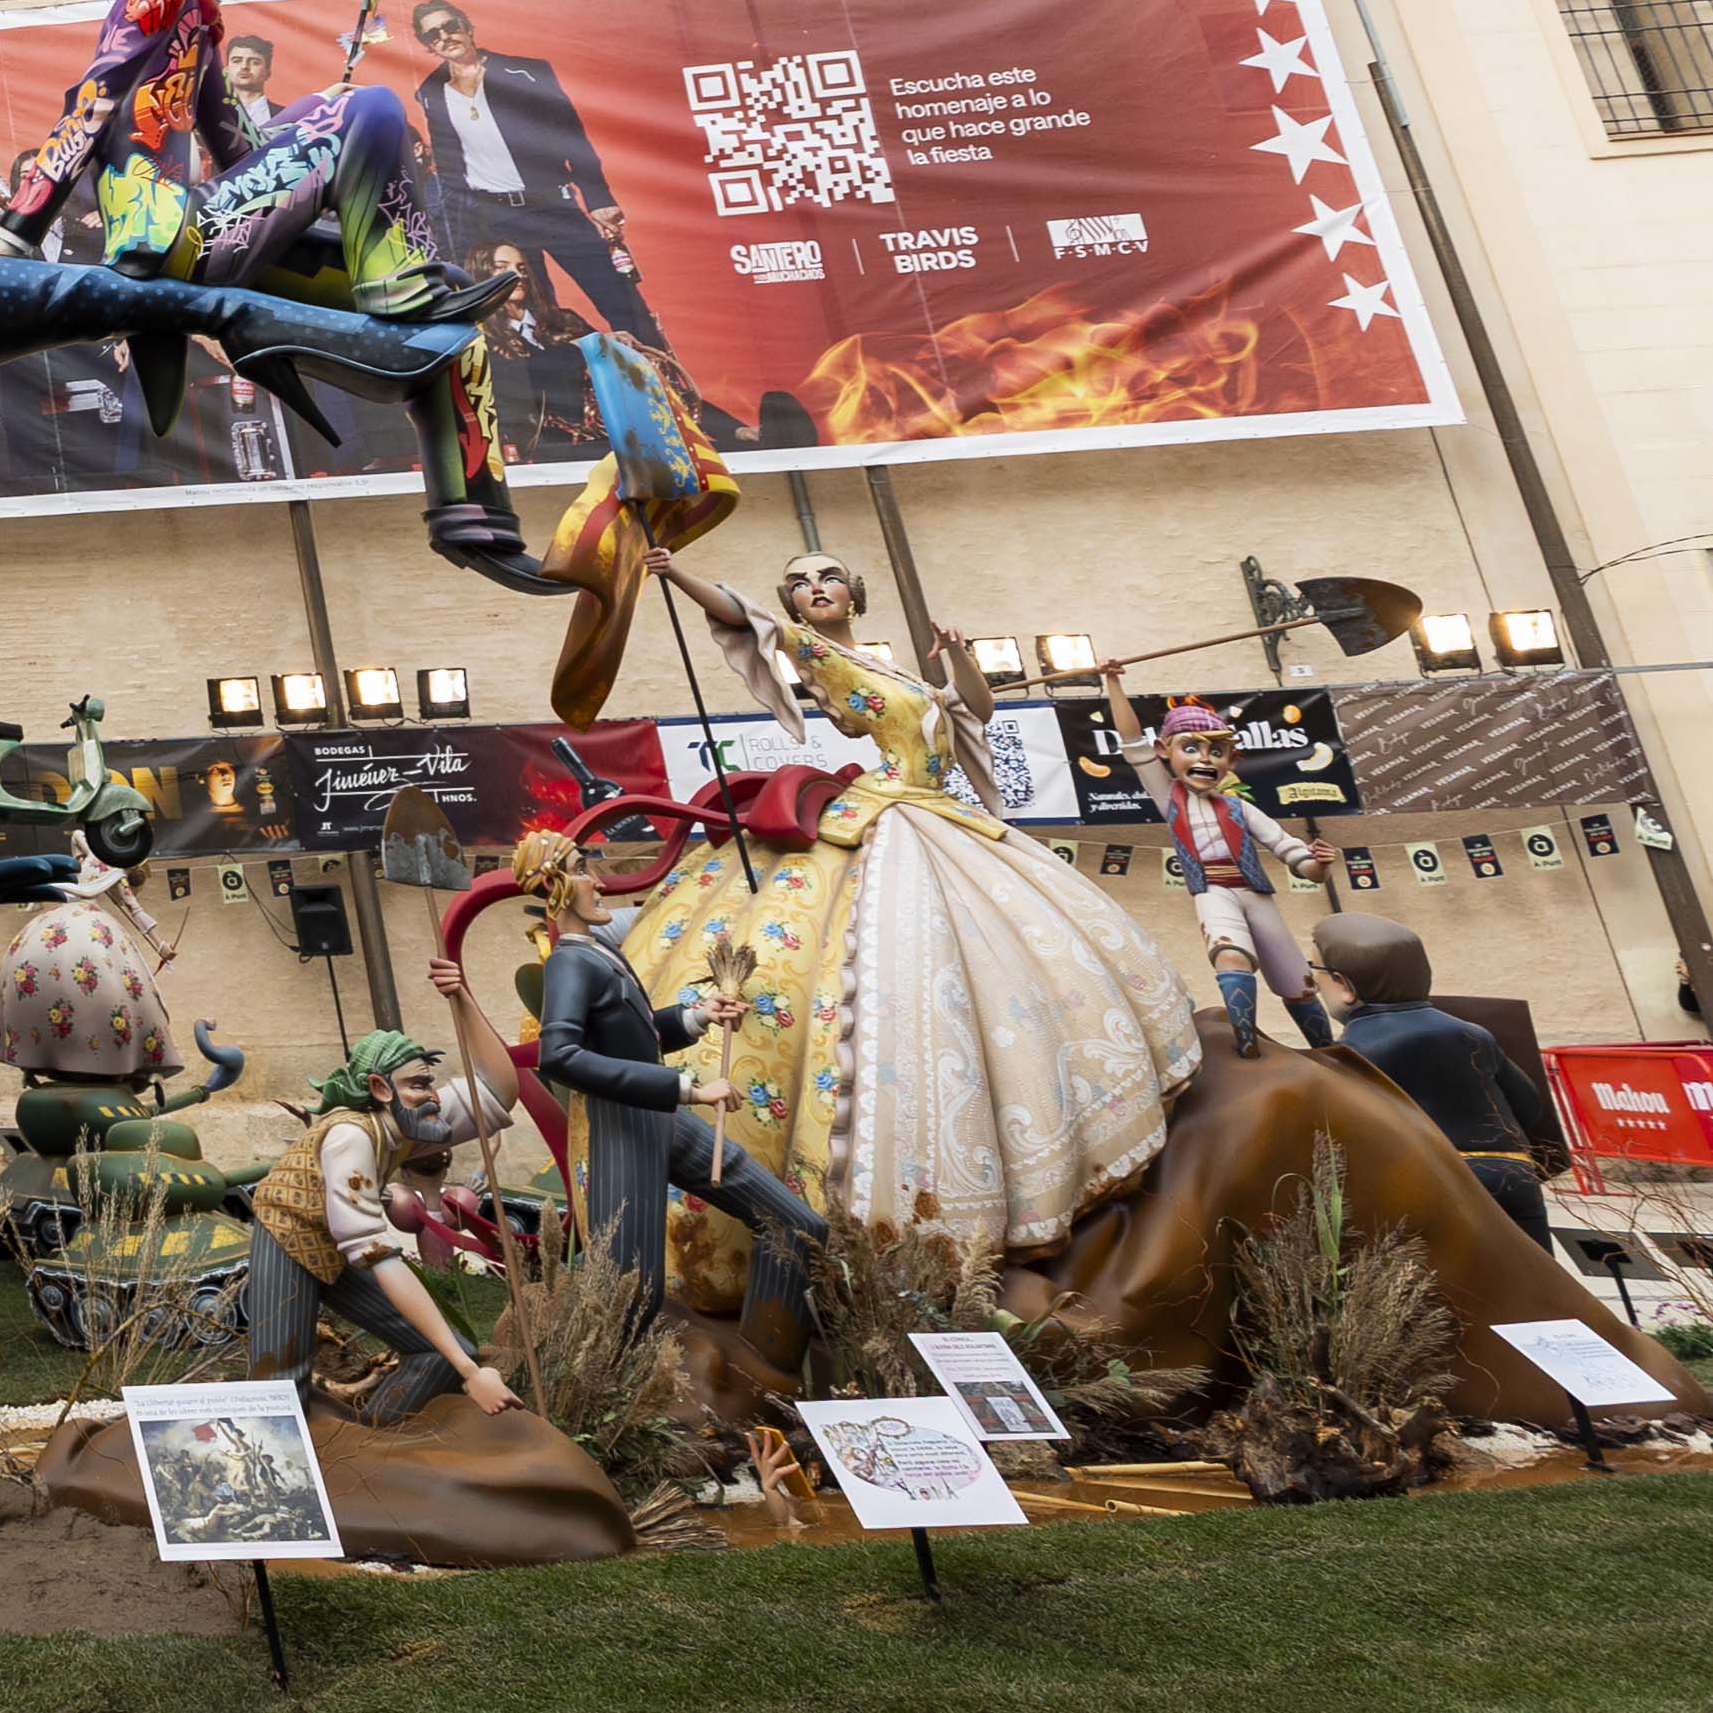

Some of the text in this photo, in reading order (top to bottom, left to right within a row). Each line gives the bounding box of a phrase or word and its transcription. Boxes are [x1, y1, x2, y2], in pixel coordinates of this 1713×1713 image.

[889, 66, 1037, 96] Escucha este
[895, 88, 1052, 120] homenaje a lo
[901, 109, 1091, 146] que hace grande
[907, 143, 994, 166] la fiesta
[879, 225, 980, 252] TRAVIS
[730, 240, 822, 275] SANTERO
[894, 249, 976, 274] BIRDS
[1384, 705, 1424, 725] VEGAMAR
[1420, 709, 1460, 729] VEGAMAR
[1487, 716, 1531, 738] VEGAMAR
[1524, 722, 1565, 743] VEGAMAR
[314, 746, 366, 756] BODEGAS
[1411, 735, 1450, 755] VEGAMAR
[1443, 739, 1484, 760] VEGAMAR
[1481, 743, 1523, 764] VEGAMAR
[1434, 765, 1476, 786] VEGAMAR
[441, 794, 477, 804] HNOS.
[1392, 787, 1434, 807] VEGAMAR
[1592, 1082, 1670, 1113] Mahou
